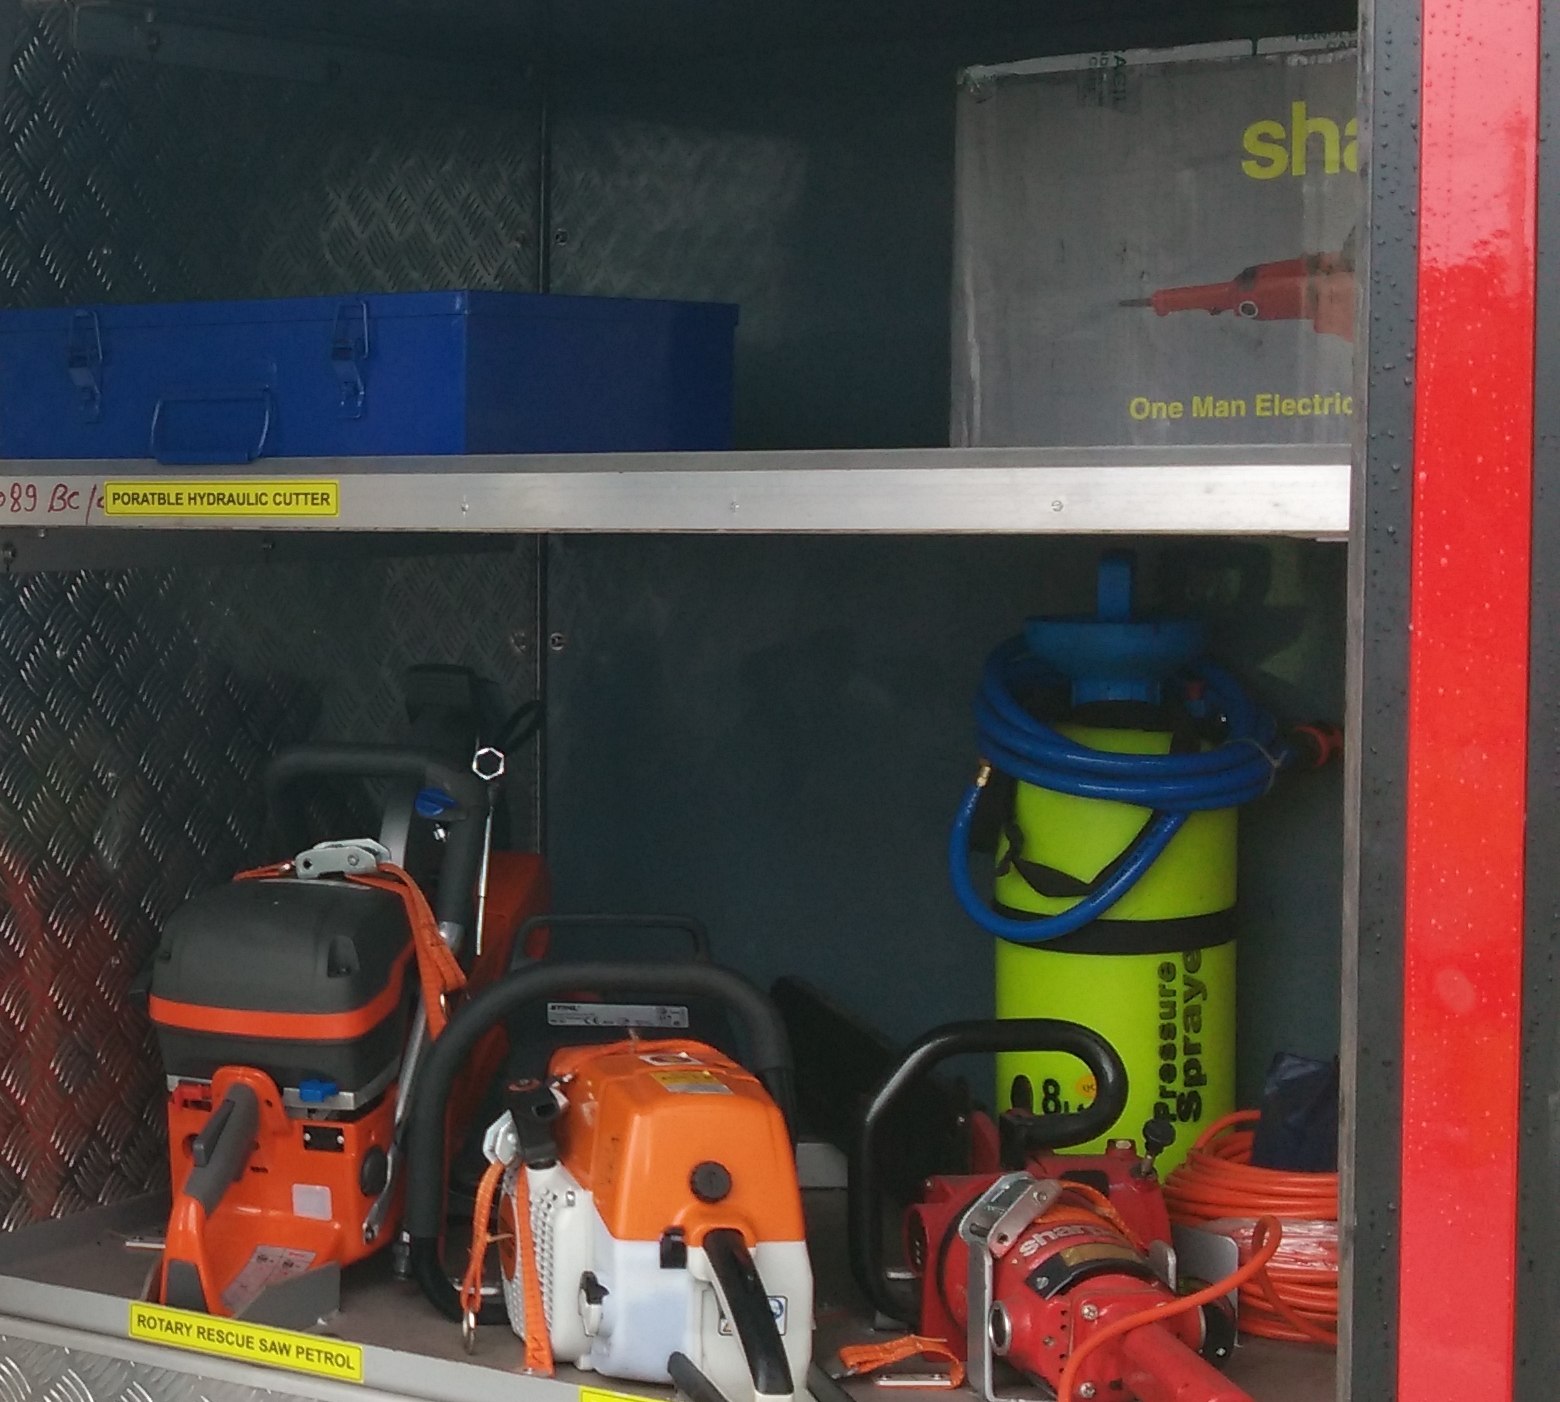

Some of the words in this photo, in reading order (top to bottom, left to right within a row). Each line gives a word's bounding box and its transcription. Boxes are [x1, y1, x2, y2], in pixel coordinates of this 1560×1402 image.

[1129, 396, 1184, 420] One
[1192, 395, 1246, 418] Man
[111, 491, 183, 507] PORATBLE
[187, 491, 270, 507] HYDRAULIC
[273, 490, 331, 507] CUTTER
[1154, 961, 1178, 1123] Pressure
[137, 1313, 193, 1337] ROTARY
[196, 1325, 255, 1351] RESCUE
[259, 1337, 292, 1358] SAW
[296, 1344, 356, 1371] PETROL
